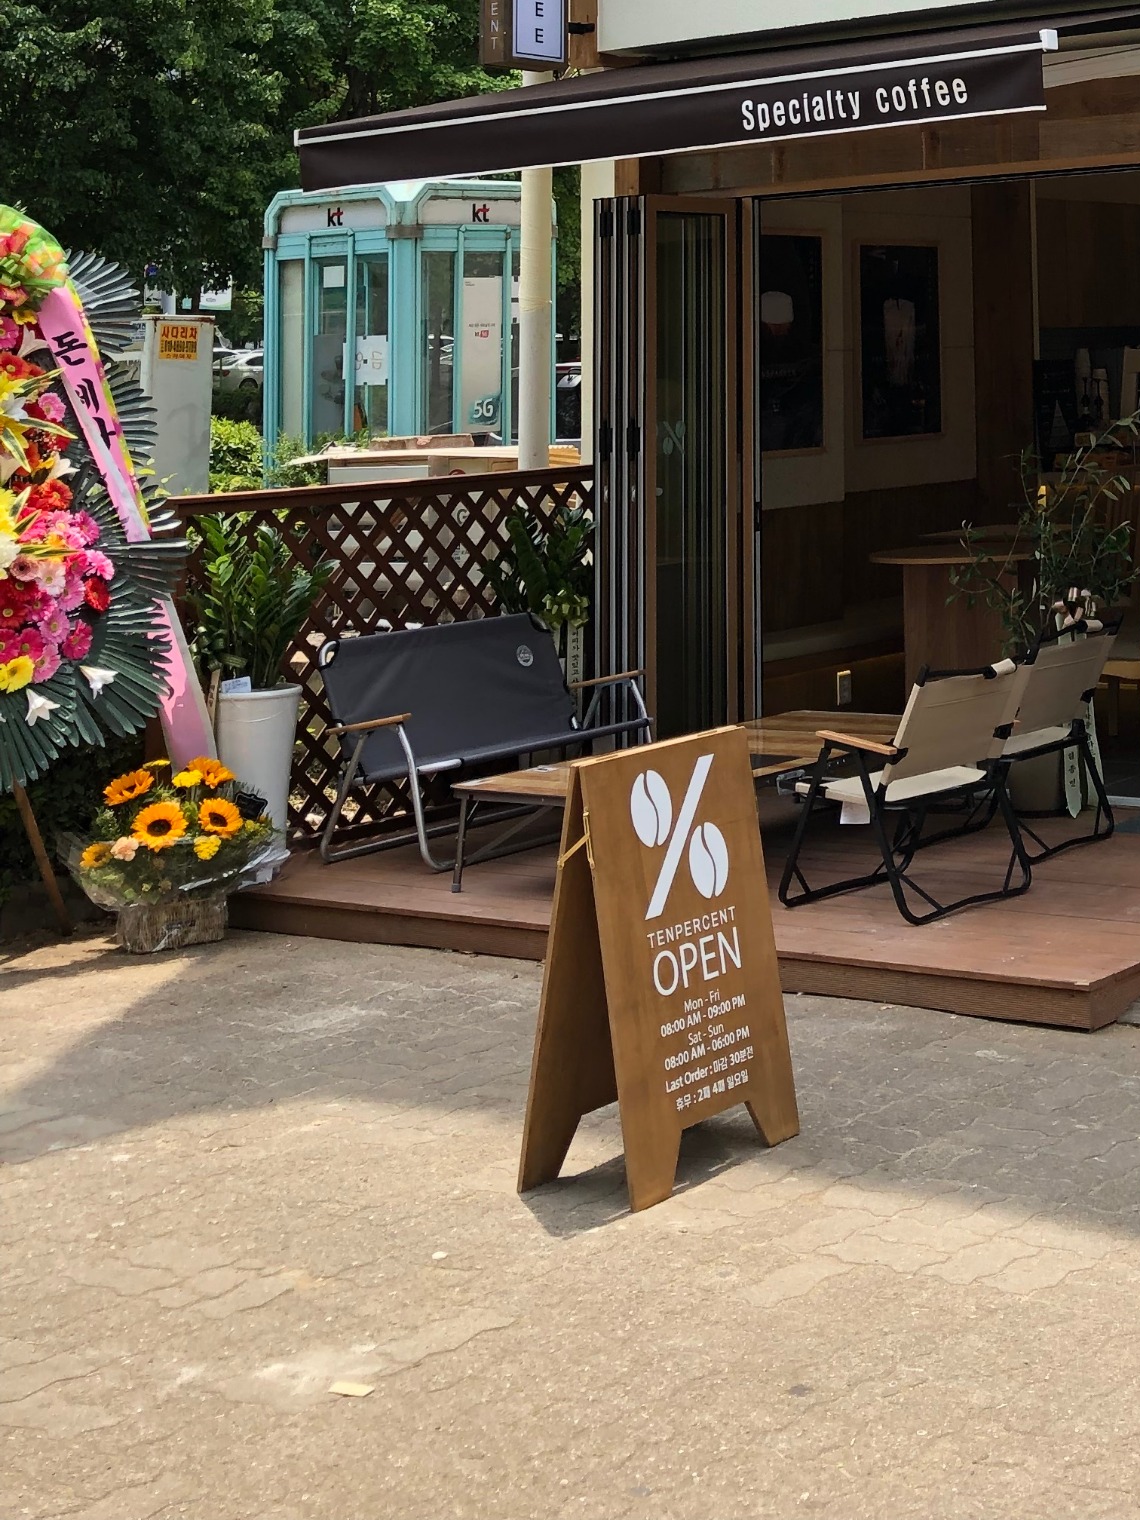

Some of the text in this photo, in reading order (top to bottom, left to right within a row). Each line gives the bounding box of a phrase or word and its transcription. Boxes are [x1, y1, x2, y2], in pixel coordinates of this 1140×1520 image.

[741, 78, 968, 131] Specialty coffee
[327, 207, 344, 227] kt
[472, 203, 491, 223] kt
[52, 331, 88, 366] 돈
[473, 397, 494, 418] 5G
[647, 906, 735, 948] TENPERCENT
[653, 926, 741, 996] OPEN
[660, 1018, 685, 1037] 08:00
[687, 1011, 701, 1028] AM
[707, 1000, 731, 1019] 09:00
[732, 993, 746, 1009] PM
[684, 998, 704, 1013] Mon
[709, 988, 720, 1003] Fri
[664, 1051, 689, 1070] 08:00
[691, 1043, 706, 1060] AM
[711, 1032, 735, 1051] 06:00
[736, 1025, 750, 1041] PM
[688, 1031, 702, 1045] Sat
[708, 1023, 724, 1037] Sun
[665, 1076, 683, 1093] Last
[684, 1067, 708, 1084] Order
[713, 1056, 728, 1072] 마감
[729, 1046, 754, 1066] 30분전
[727, 1069, 749, 1090] 일요일
